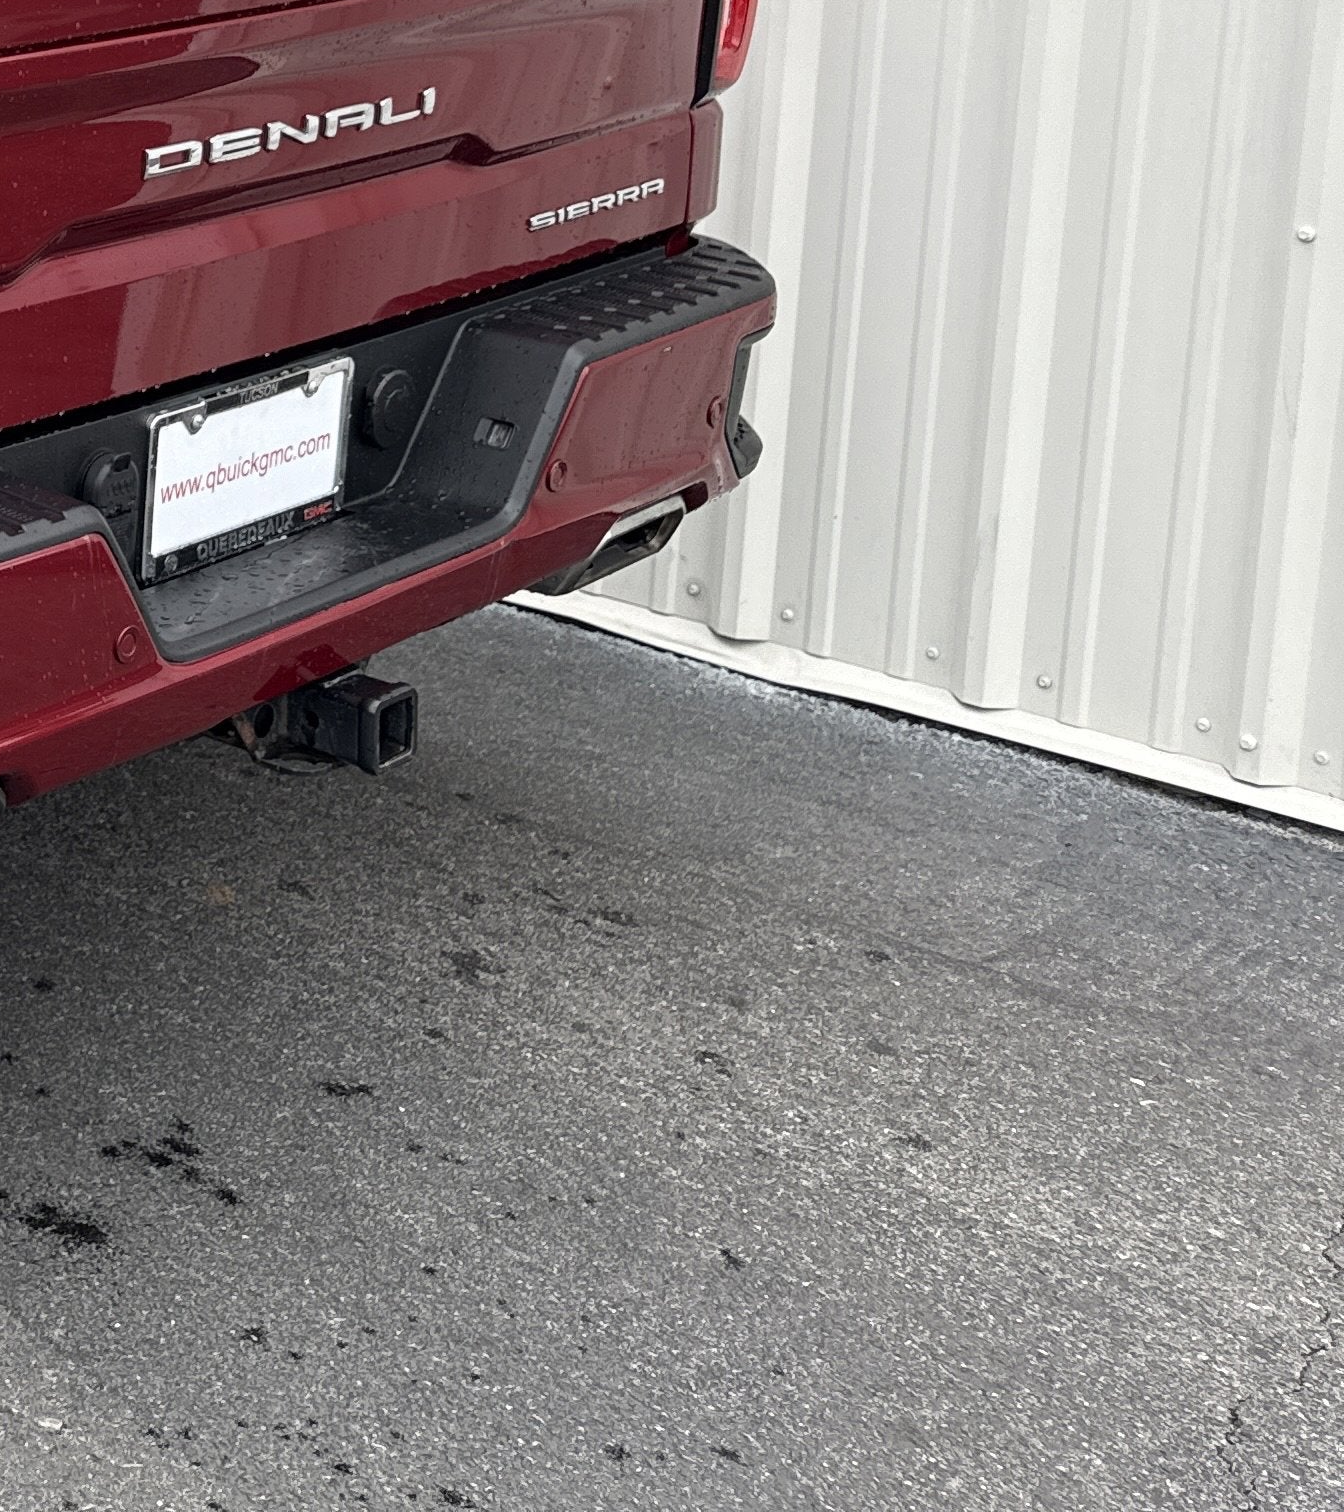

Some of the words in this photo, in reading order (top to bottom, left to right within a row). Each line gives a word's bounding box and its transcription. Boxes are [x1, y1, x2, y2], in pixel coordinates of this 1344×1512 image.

[143, 87, 436, 180] DENALI
[528, 178, 665, 232] SIERRA
[239, 382, 279, 405] TUCSON
[161, 432, 331, 504] www.qbuickgmc.com
[197, 512, 295, 561] QUEBEDEAUX
[304, 501, 333, 520] GMC
